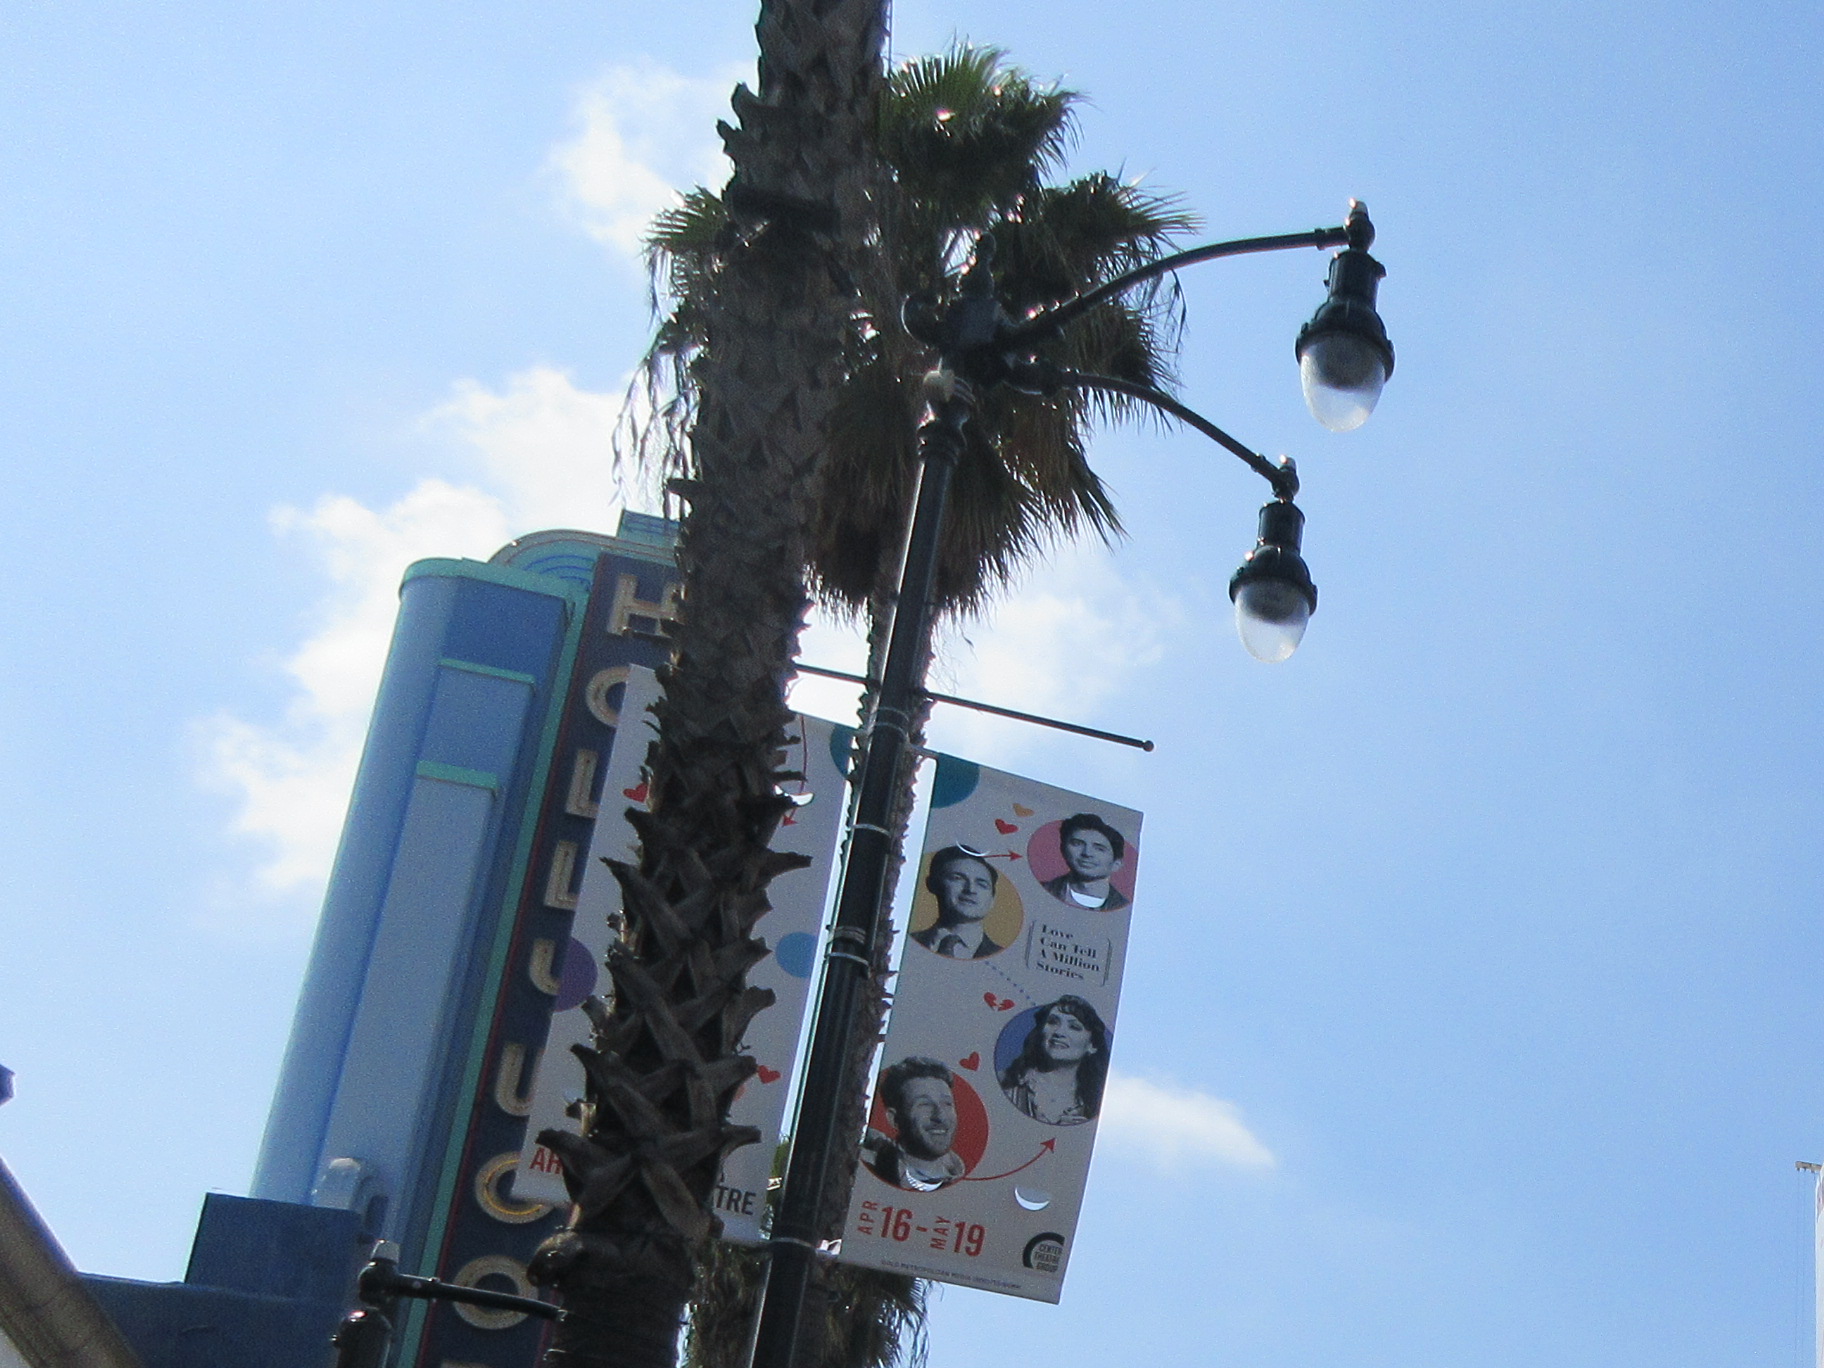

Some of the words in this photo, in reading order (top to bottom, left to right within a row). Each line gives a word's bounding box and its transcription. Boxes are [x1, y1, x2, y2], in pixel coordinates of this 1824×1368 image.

[1042, 924, 1074, 939] Love
[1040, 937, 1066, 952] Can
[1073, 944, 1097, 959] Tell
[1037, 961, 1084, 980] Stories
[1052, 951, 1100, 972] Million
[857, 1200, 880, 1236] APR
[881, 1206, 913, 1242] 16
[930, 1215, 951, 1250] MAY
[954, 1221, 986, 1258] 19
